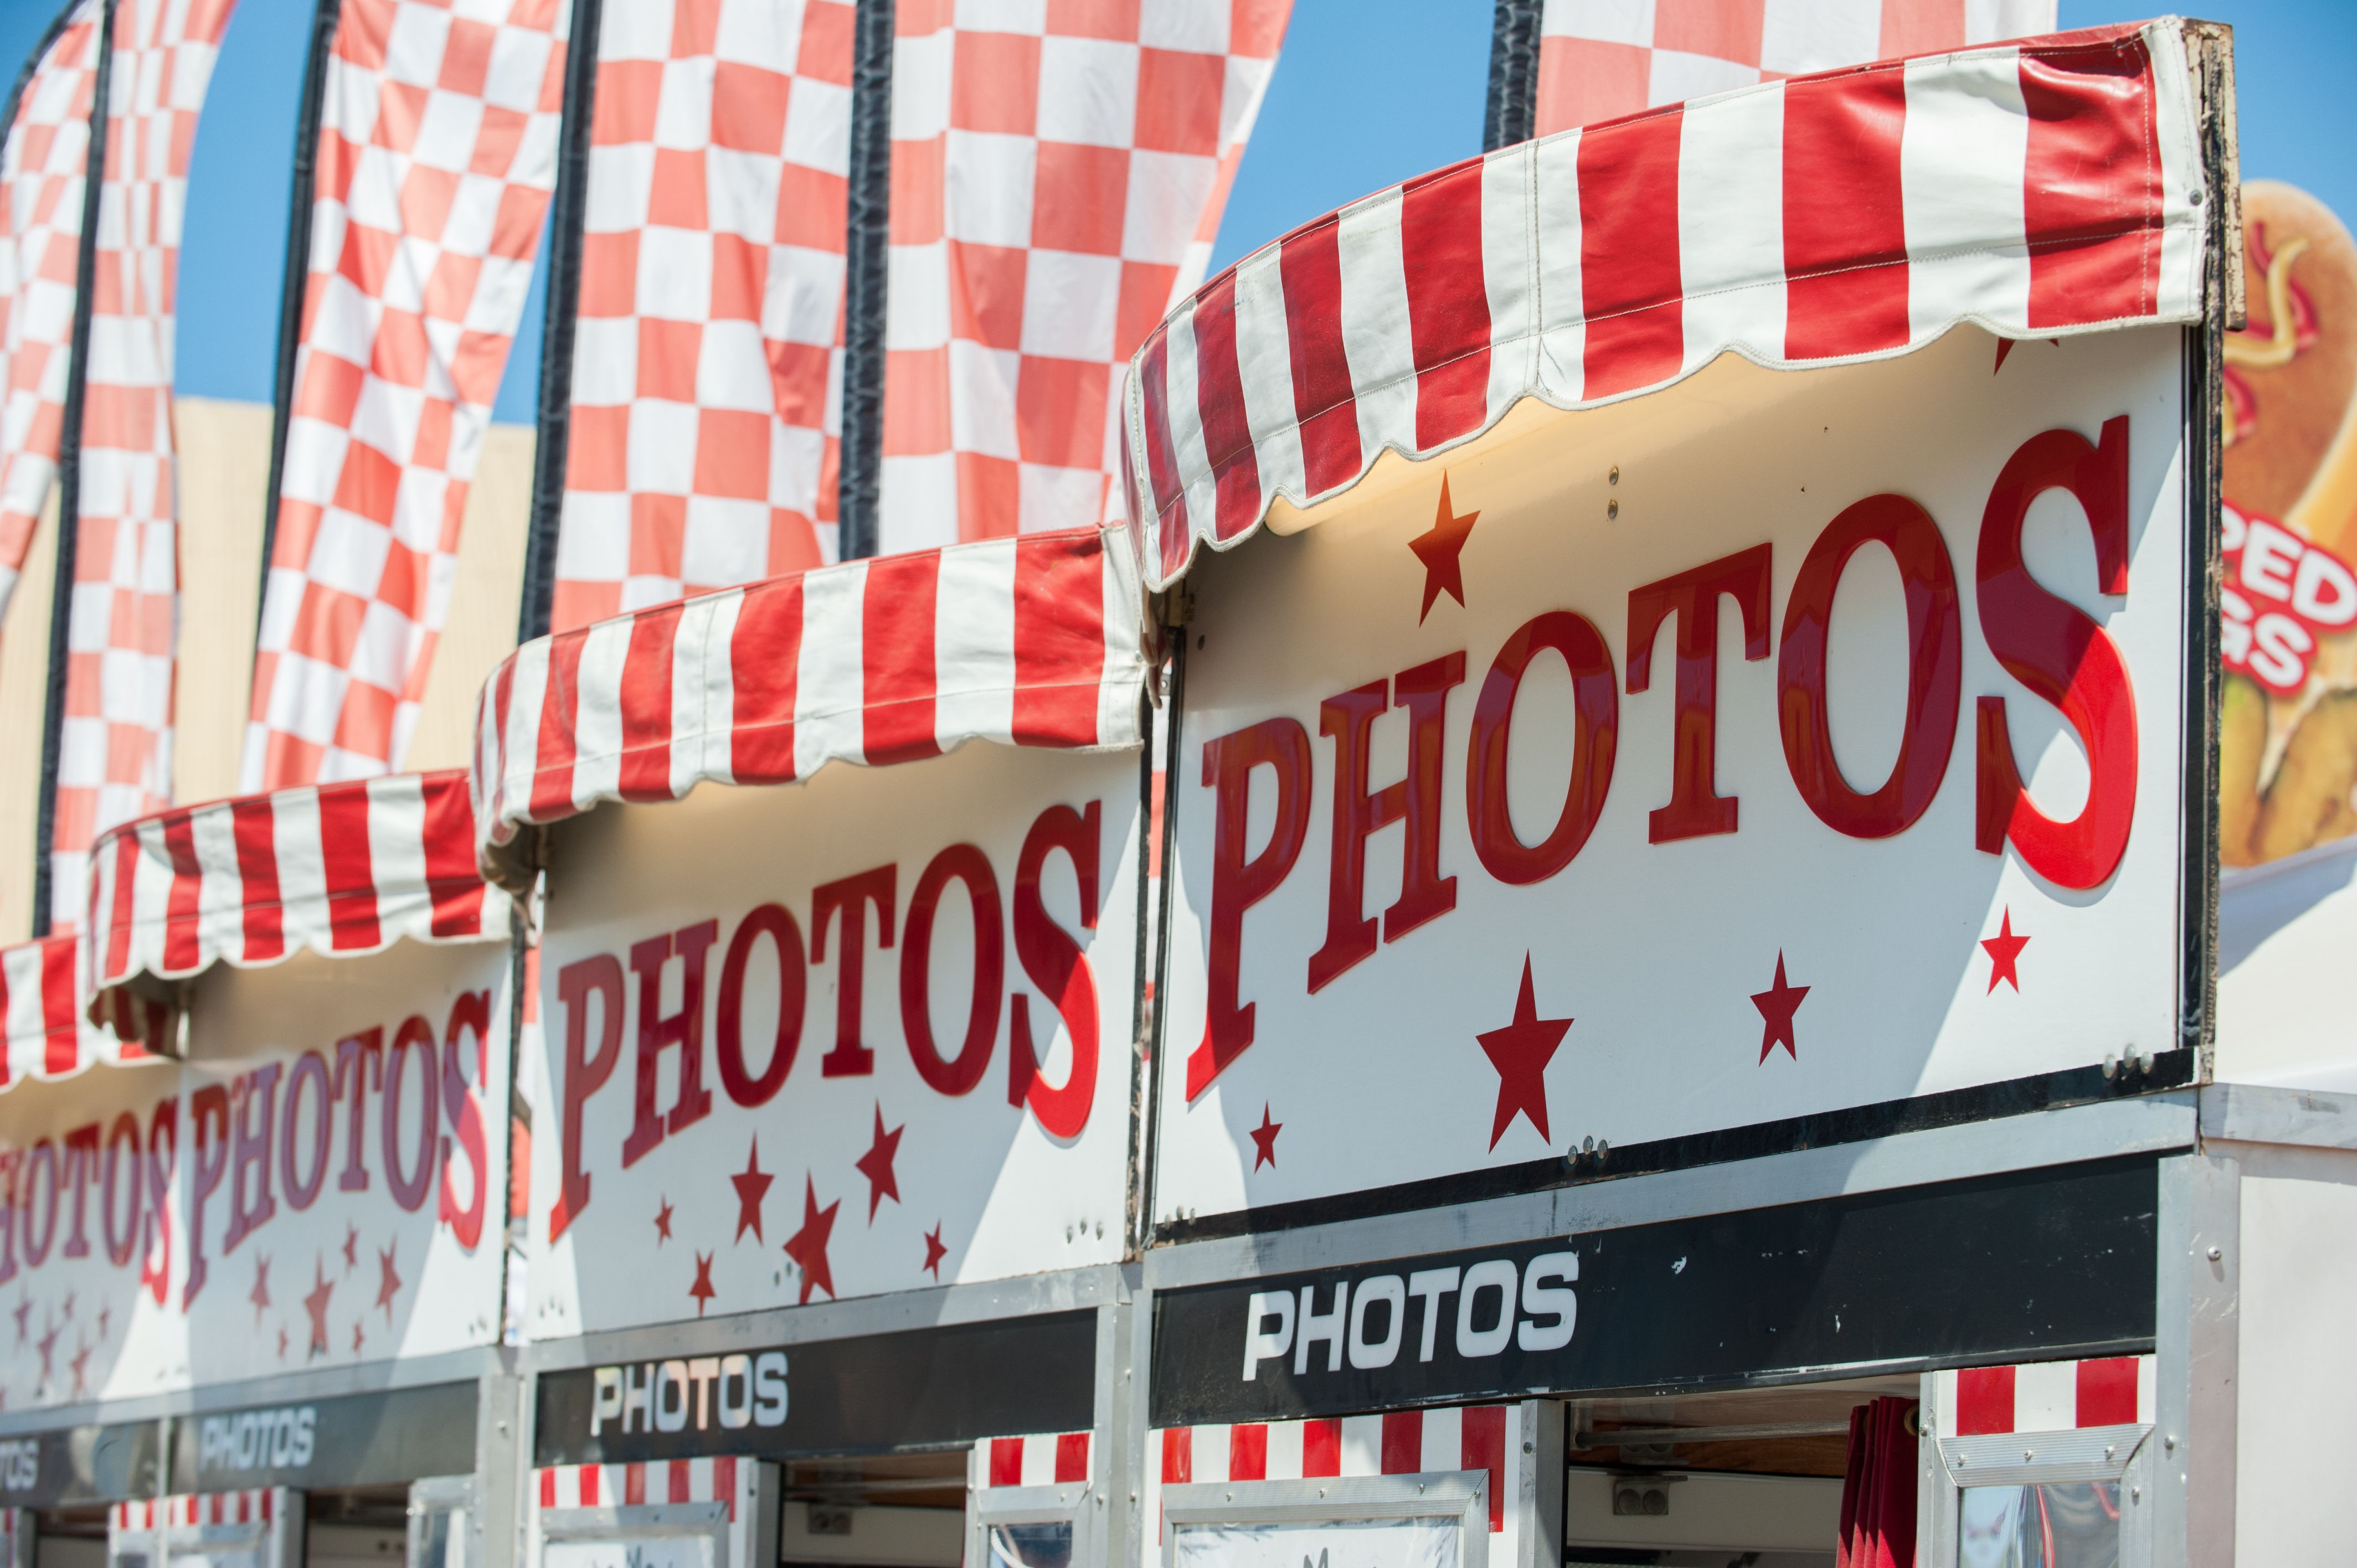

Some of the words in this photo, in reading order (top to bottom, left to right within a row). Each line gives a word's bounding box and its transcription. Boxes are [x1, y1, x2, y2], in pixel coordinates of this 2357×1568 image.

[1187, 414, 2138, 1102] PHOTOS
[549, 800, 1102, 1244] PHOTOS
[183, 989, 490, 1313] PHOTOS
[590, 1351, 789, 1437] PHOTOS
[1243, 1251, 1579, 1381] PHOTOS
[199, 1407, 316, 1471] PHOTOS
